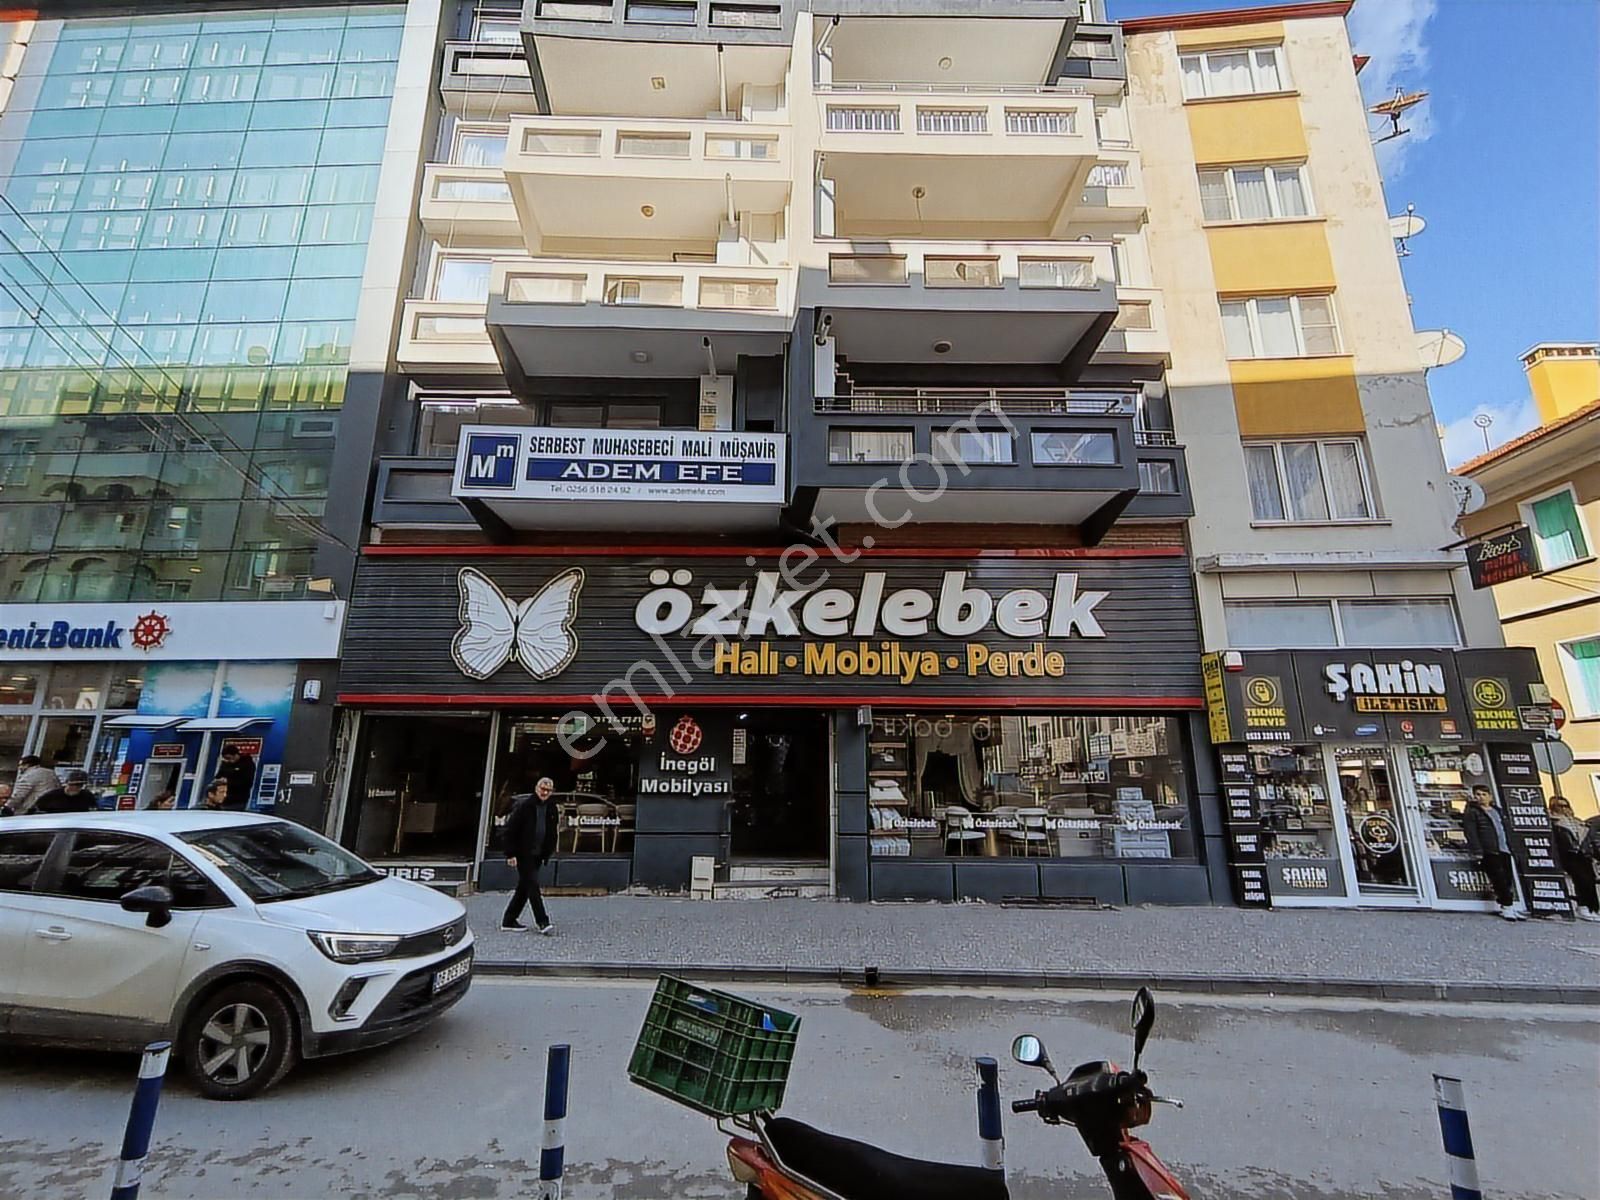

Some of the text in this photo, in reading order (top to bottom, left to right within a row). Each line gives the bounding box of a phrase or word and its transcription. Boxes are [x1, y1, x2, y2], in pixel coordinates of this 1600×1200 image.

[529, 436, 777, 461] SERBEST MUHASEBECİ MALİ MÜŞAVİR
[560, 462, 743, 481] ADEM EFE
[634, 569, 1110, 638] özkelebek
[714, 642, 1065, 685] Halı Mobilya Perde
[660, 752, 715, 774] İnegöl
[641, 779, 728, 797] Mobilyası
[1282, 867, 1327, 884] ŞAHİN
